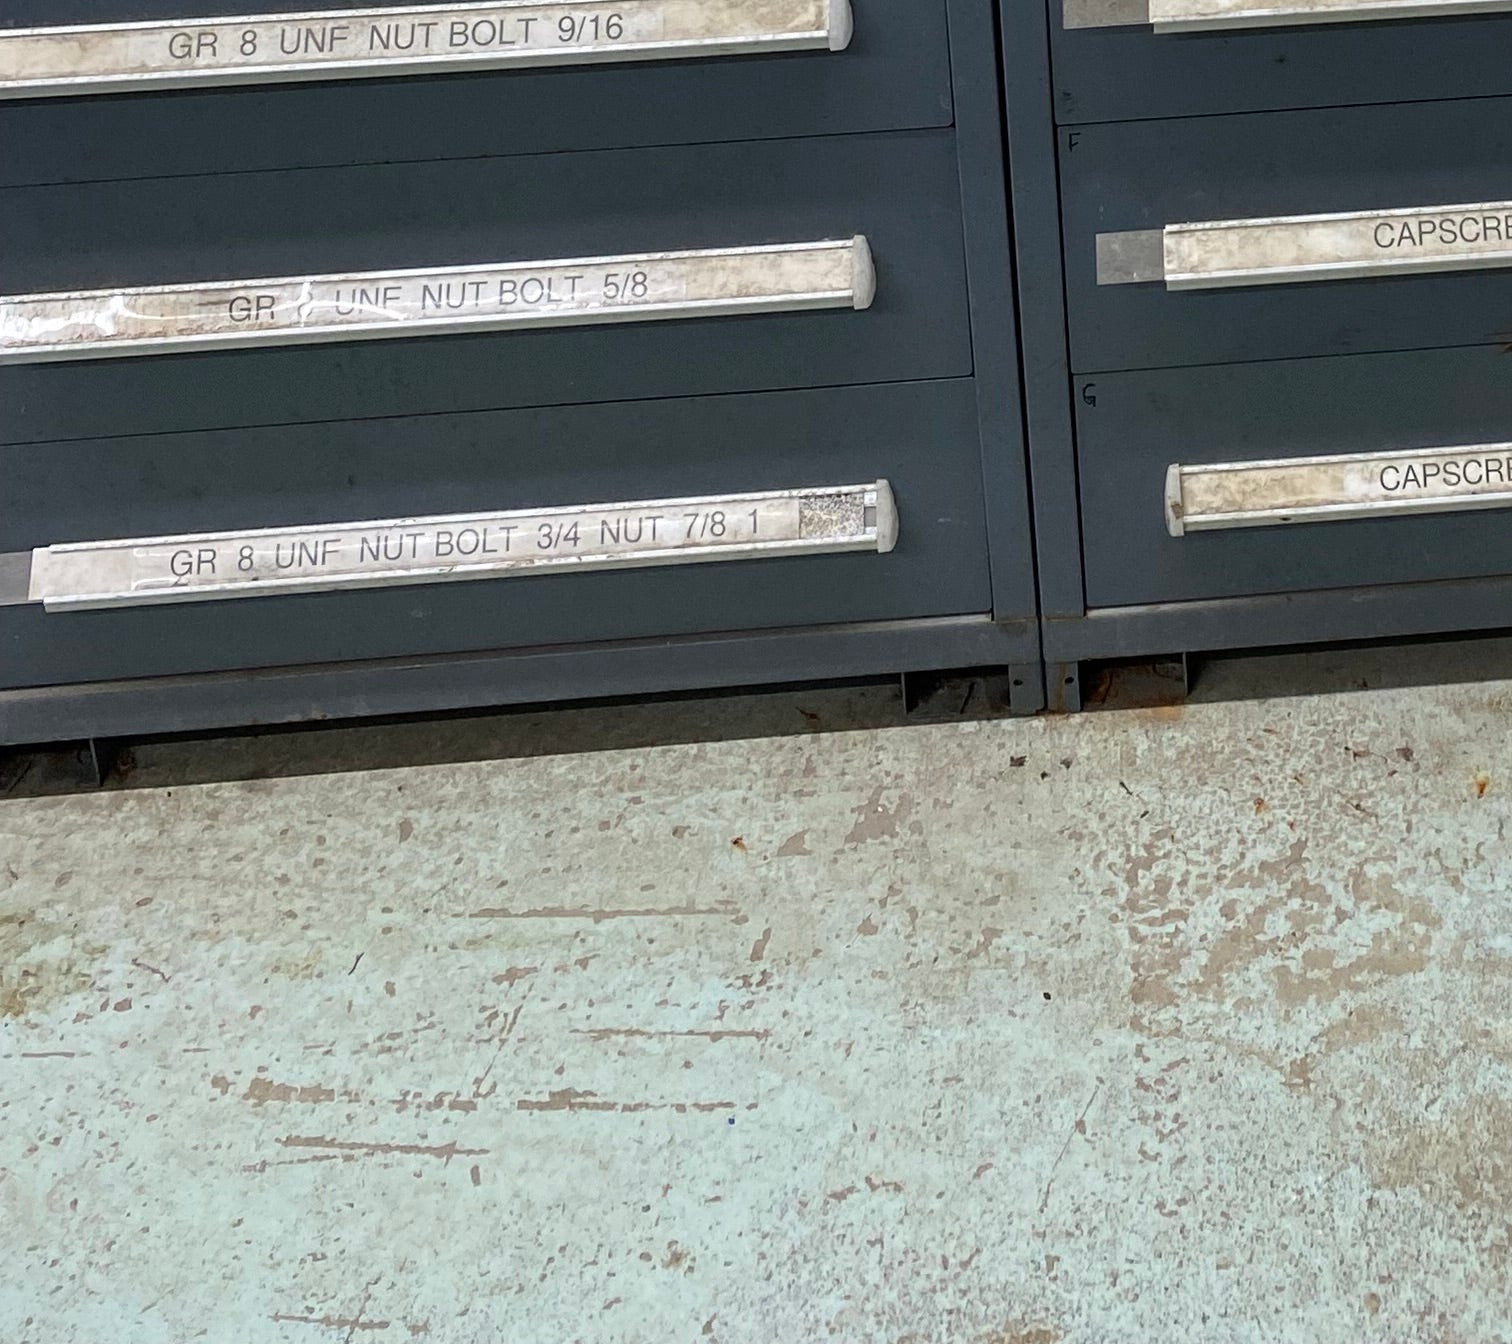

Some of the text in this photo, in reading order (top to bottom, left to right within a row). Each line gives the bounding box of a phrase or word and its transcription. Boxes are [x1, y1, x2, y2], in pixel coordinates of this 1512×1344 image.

[167, 14, 625, 61] GR 8 UNF NUT BOLT 9/16
[1068, 132, 1082, 153] F
[228, 271, 650, 322] GR UNF NUT BOLT 5/8
[169, 508, 760, 577] GR 8 UNF NUT BOLT 3/4 NUT 7/8 1
